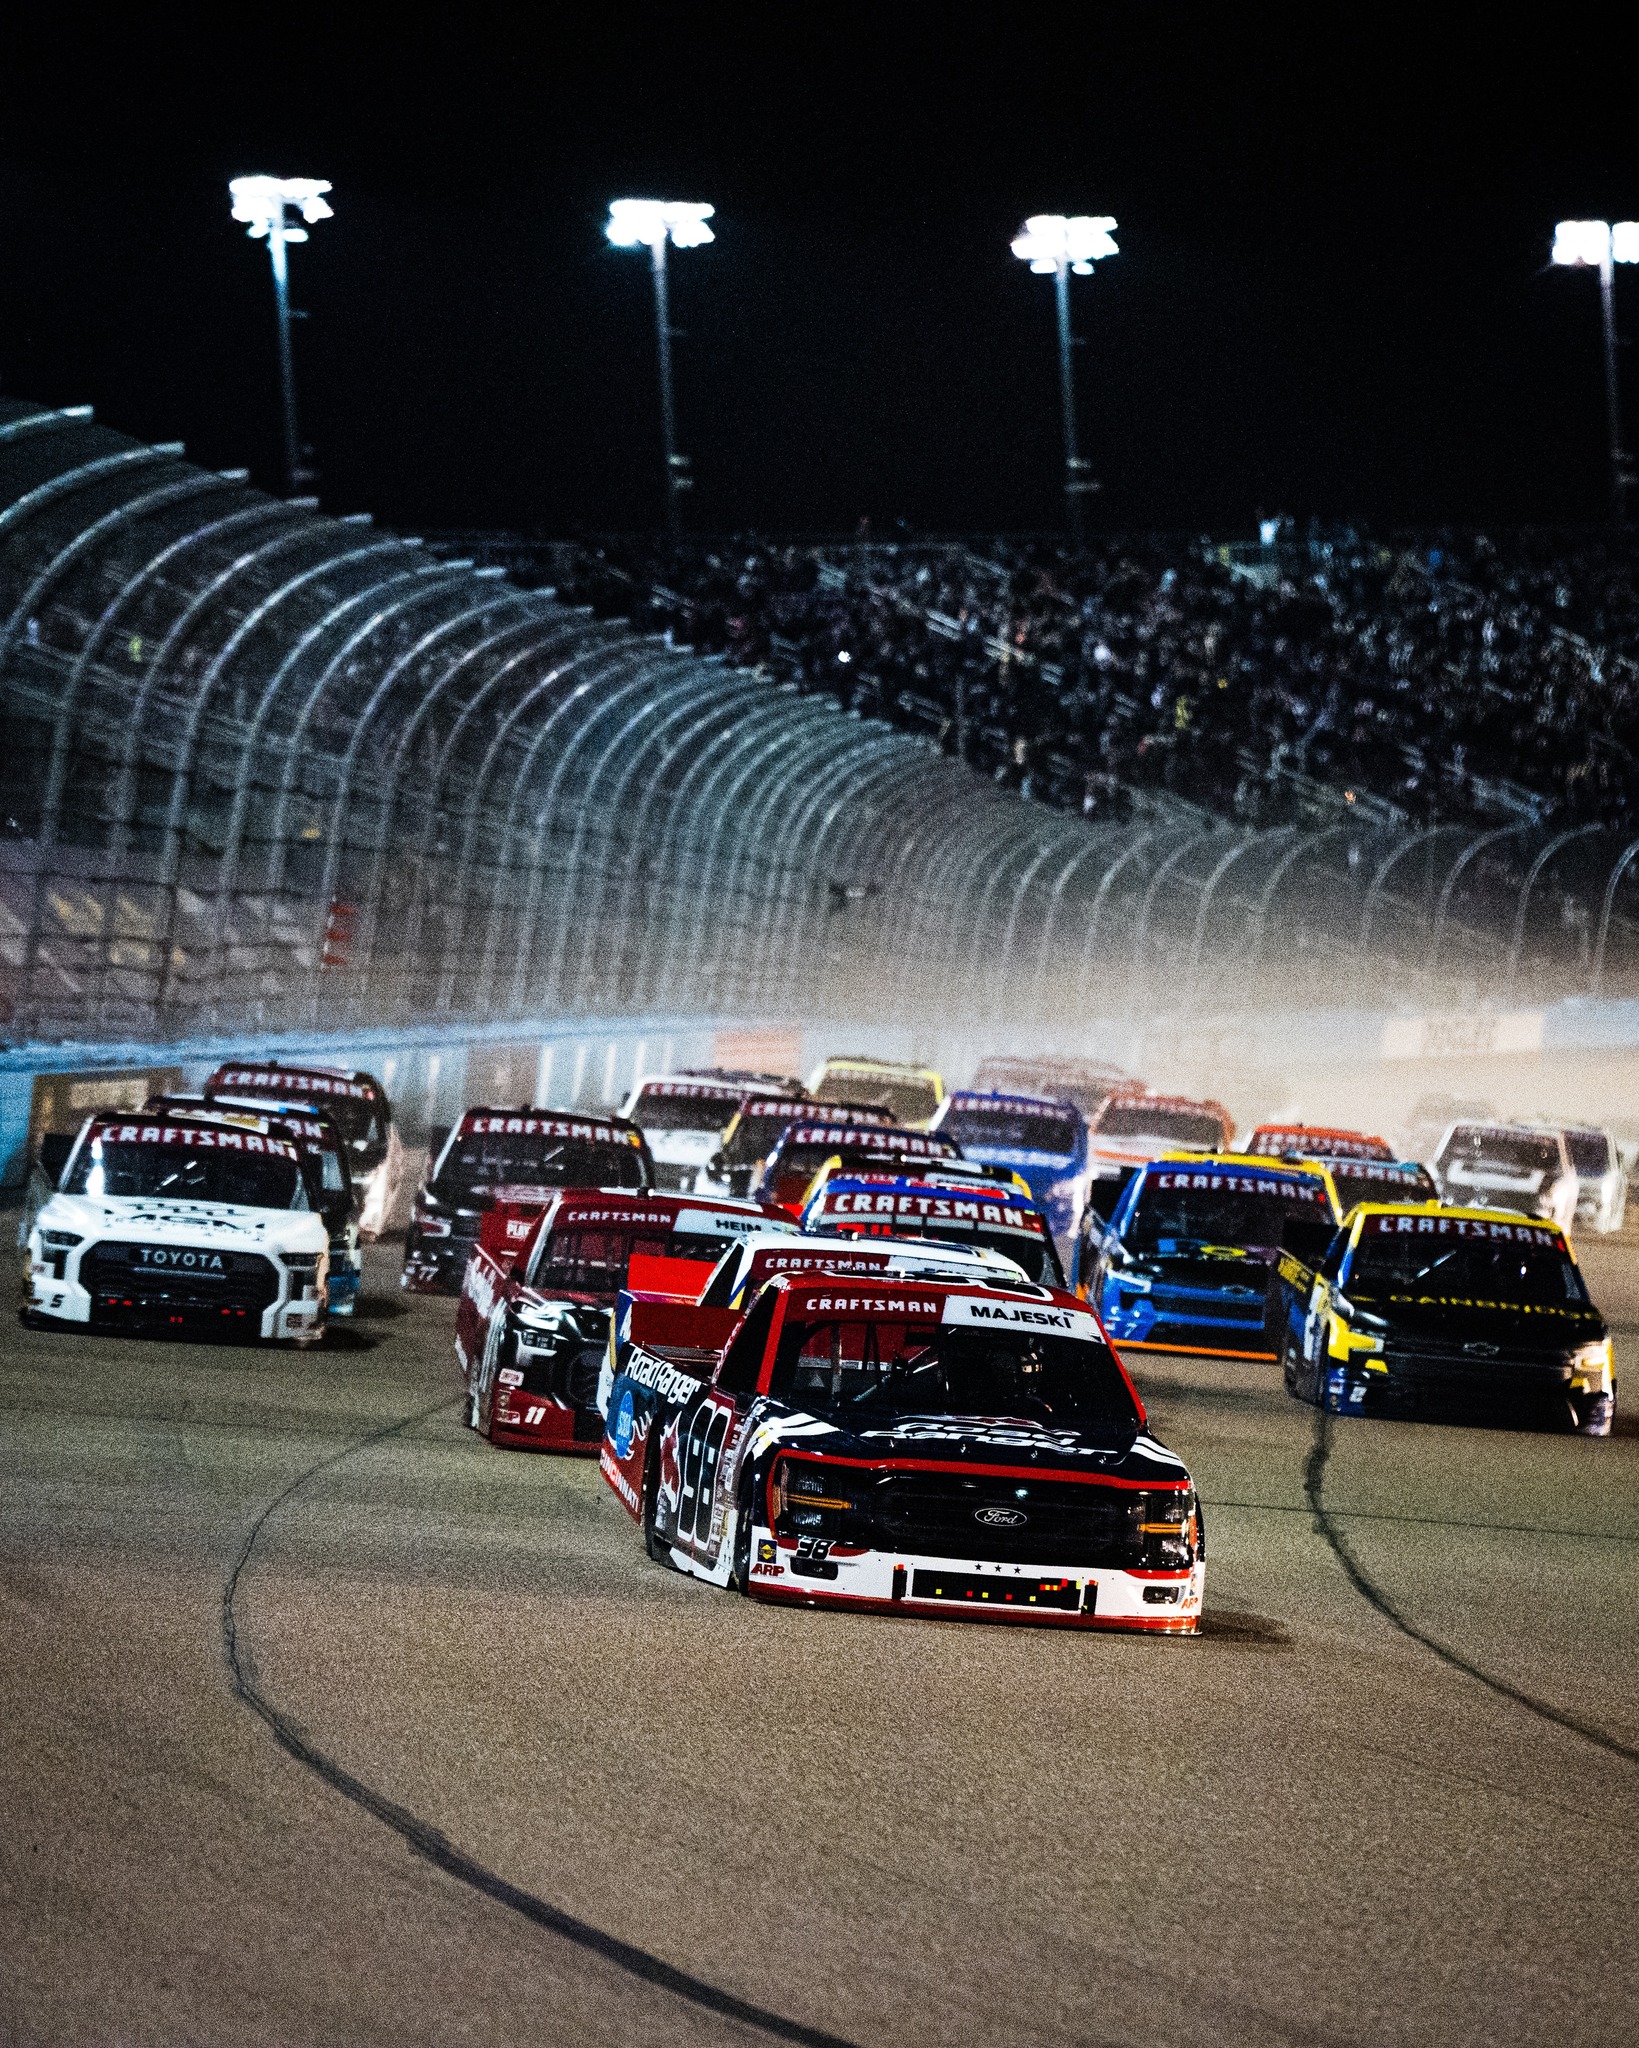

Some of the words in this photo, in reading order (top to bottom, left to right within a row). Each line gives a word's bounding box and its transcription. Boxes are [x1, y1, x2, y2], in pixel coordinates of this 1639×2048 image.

[223, 1072, 364, 1098] CRAFTSMAN
[751, 1102, 879, 1124] CRAFTSMAN
[101, 1125, 285, 1155] CRAFTSMAN
[473, 1118, 629, 1145] CRAFTSMAN
[796, 1129, 943, 1157] CRAFTSMAN
[1159, 1173, 1314, 1201] CRAFTSMAN
[568, 1211, 671, 1224] CRAFTSMAN
[835, 1194, 1024, 1227] CRAFTSMAN
[1380, 1216, 1552, 1247] CRAFTSMAN
[140, 1248, 223, 1270] TOYOTA
[765, 1258, 880, 1271] CRAFTSMAN
[806, 1298, 937, 1314] CRAFTSMAN
[970, 1305, 1072, 1329] MAJESKI
[525, 1406, 546, 1425] 11
[600, 1448, 639, 1514] CINCINNATI
[983, 1509, 1019, 1524] Ford
[751, 1563, 785, 1577] ARP
